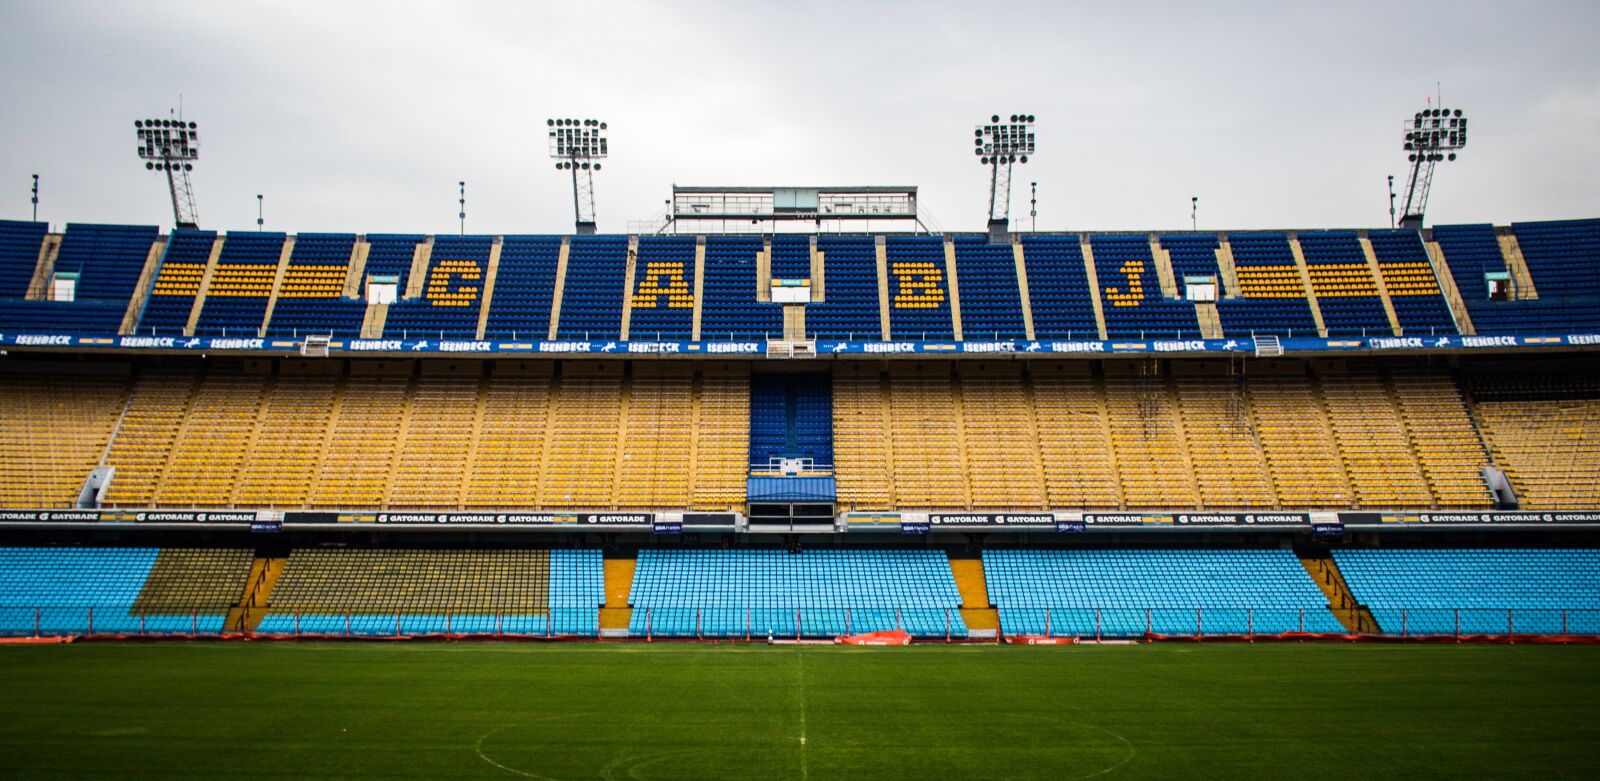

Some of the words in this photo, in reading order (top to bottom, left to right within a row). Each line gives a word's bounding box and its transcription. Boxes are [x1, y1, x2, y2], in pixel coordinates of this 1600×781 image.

[427, 261, 481, 306] C
[632, 262, 693, 307] A
[893, 262, 944, 307] B
[1106, 261, 1144, 306] J
[15, 334, 73, 346] ISENBECK
[119, 337, 176, 347] ISENBECK
[210, 338, 266, 349] ISENBECK
[1461, 336, 1518, 347] ISENBECK
[350, 341, 406, 351] ISENBECK
[439, 342, 492, 352] ISENBECK
[538, 342, 592, 353] ISENBECK
[706, 342, 759, 353] ISENBECK
[863, 342, 915, 353] ISENBECK
[963, 342, 1015, 353] ISENBECK
[1052, 342, 1105, 353] ISENBECK
[1153, 341, 1207, 352] ISENBECK
[52, 513, 98, 521] GATORADE
[148, 513, 195, 521] GATORADE
[449, 515, 496, 523] GATORADE
[508, 515, 555, 523] GATORADE
[600, 515, 646, 523] GATORADE
[943, 516, 989, 524] GATORADE
[1096, 515, 1142, 523] GATORADE
[1191, 515, 1237, 523] GATORADE
[1493, 514, 1540, 522] GATORADE
